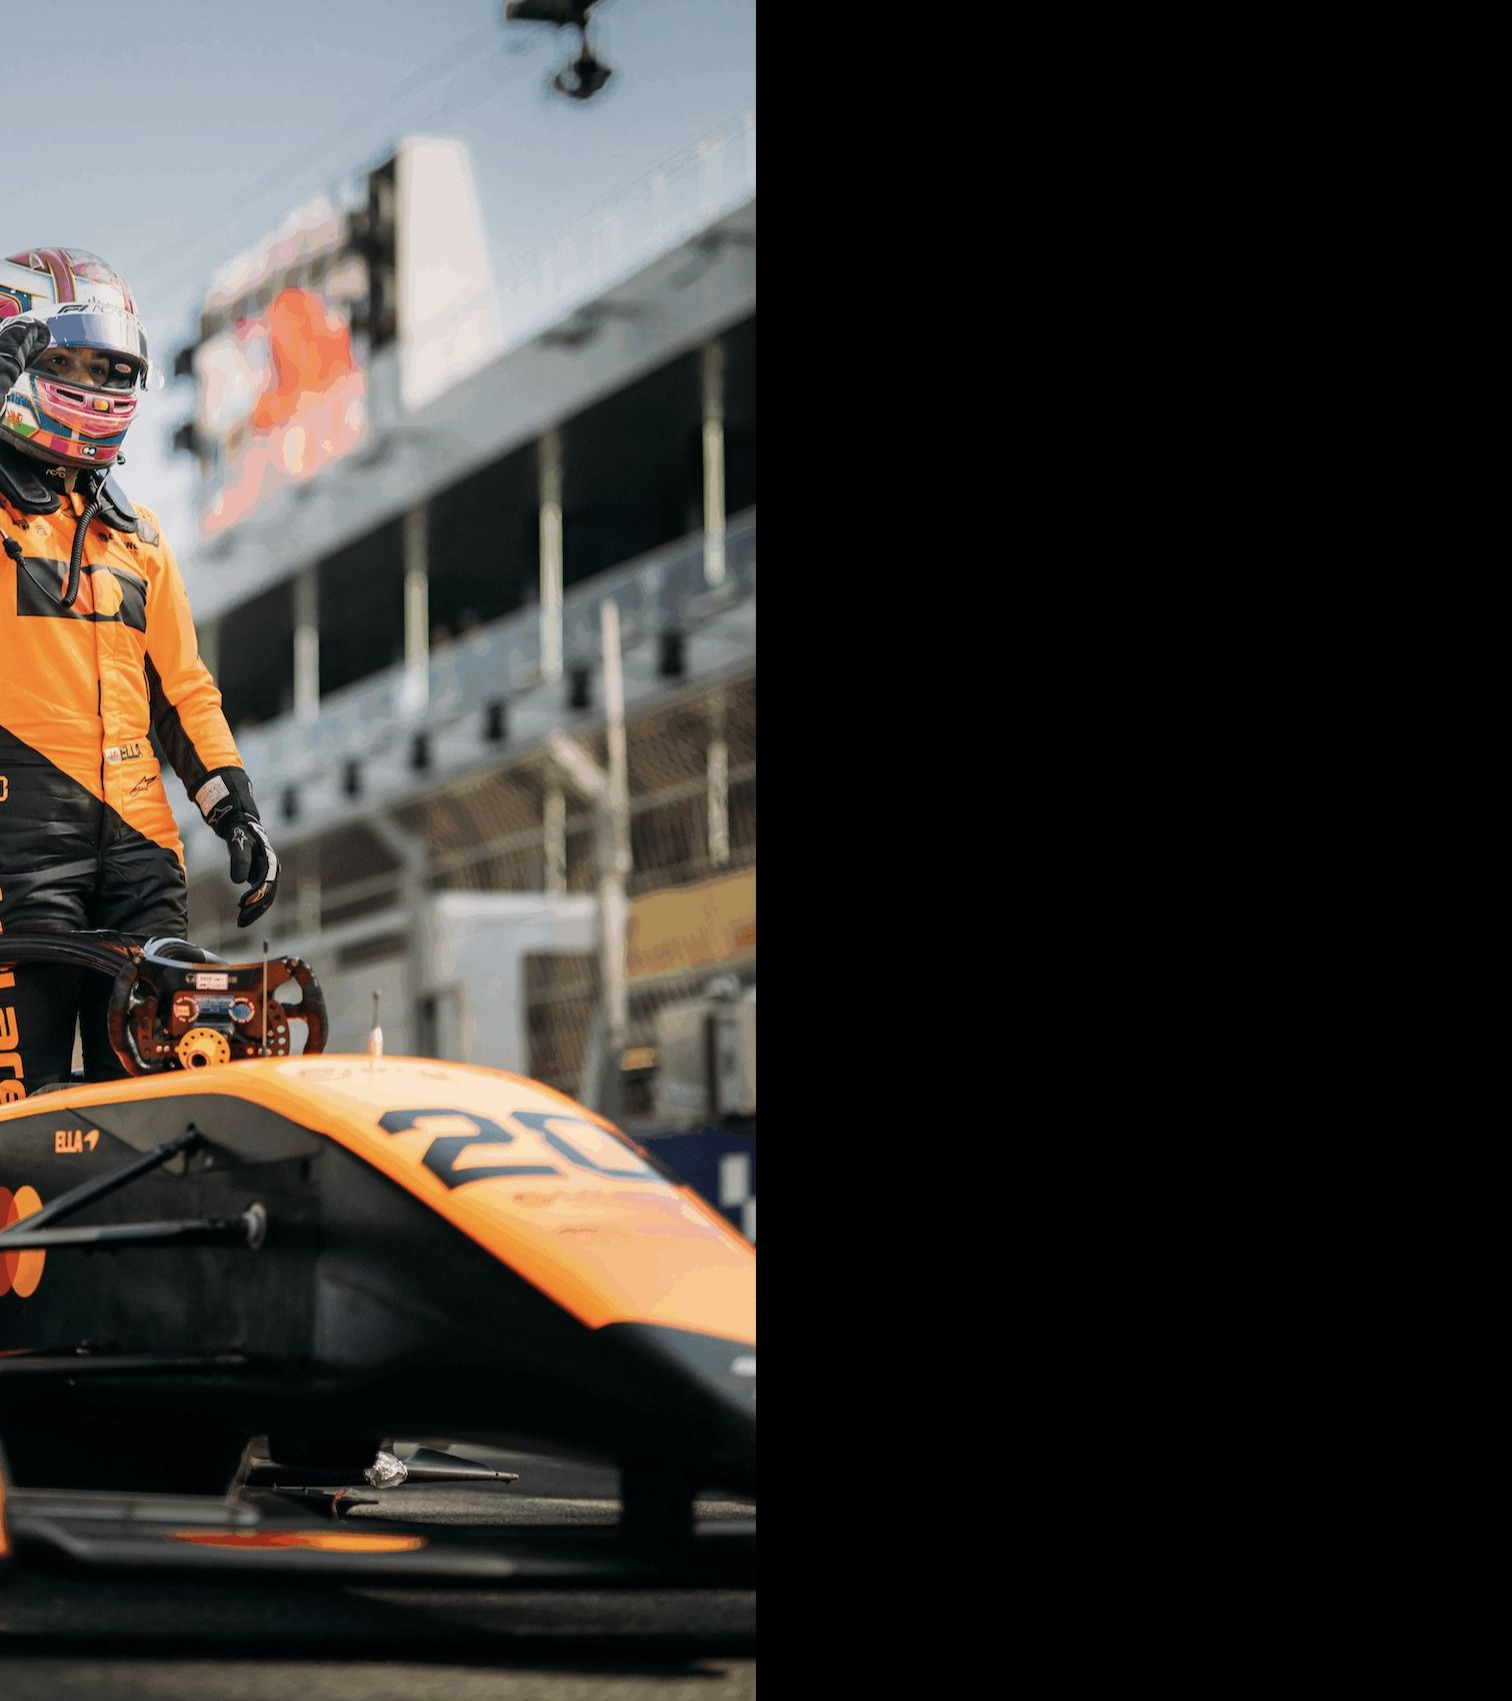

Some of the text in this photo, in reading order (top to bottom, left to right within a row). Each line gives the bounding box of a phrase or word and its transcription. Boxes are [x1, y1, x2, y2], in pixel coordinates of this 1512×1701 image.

[120, 743, 143, 760] ELLA
[55, 1130, 83, 1153] ELLA
[377, 1108, 671, 1190] 20
